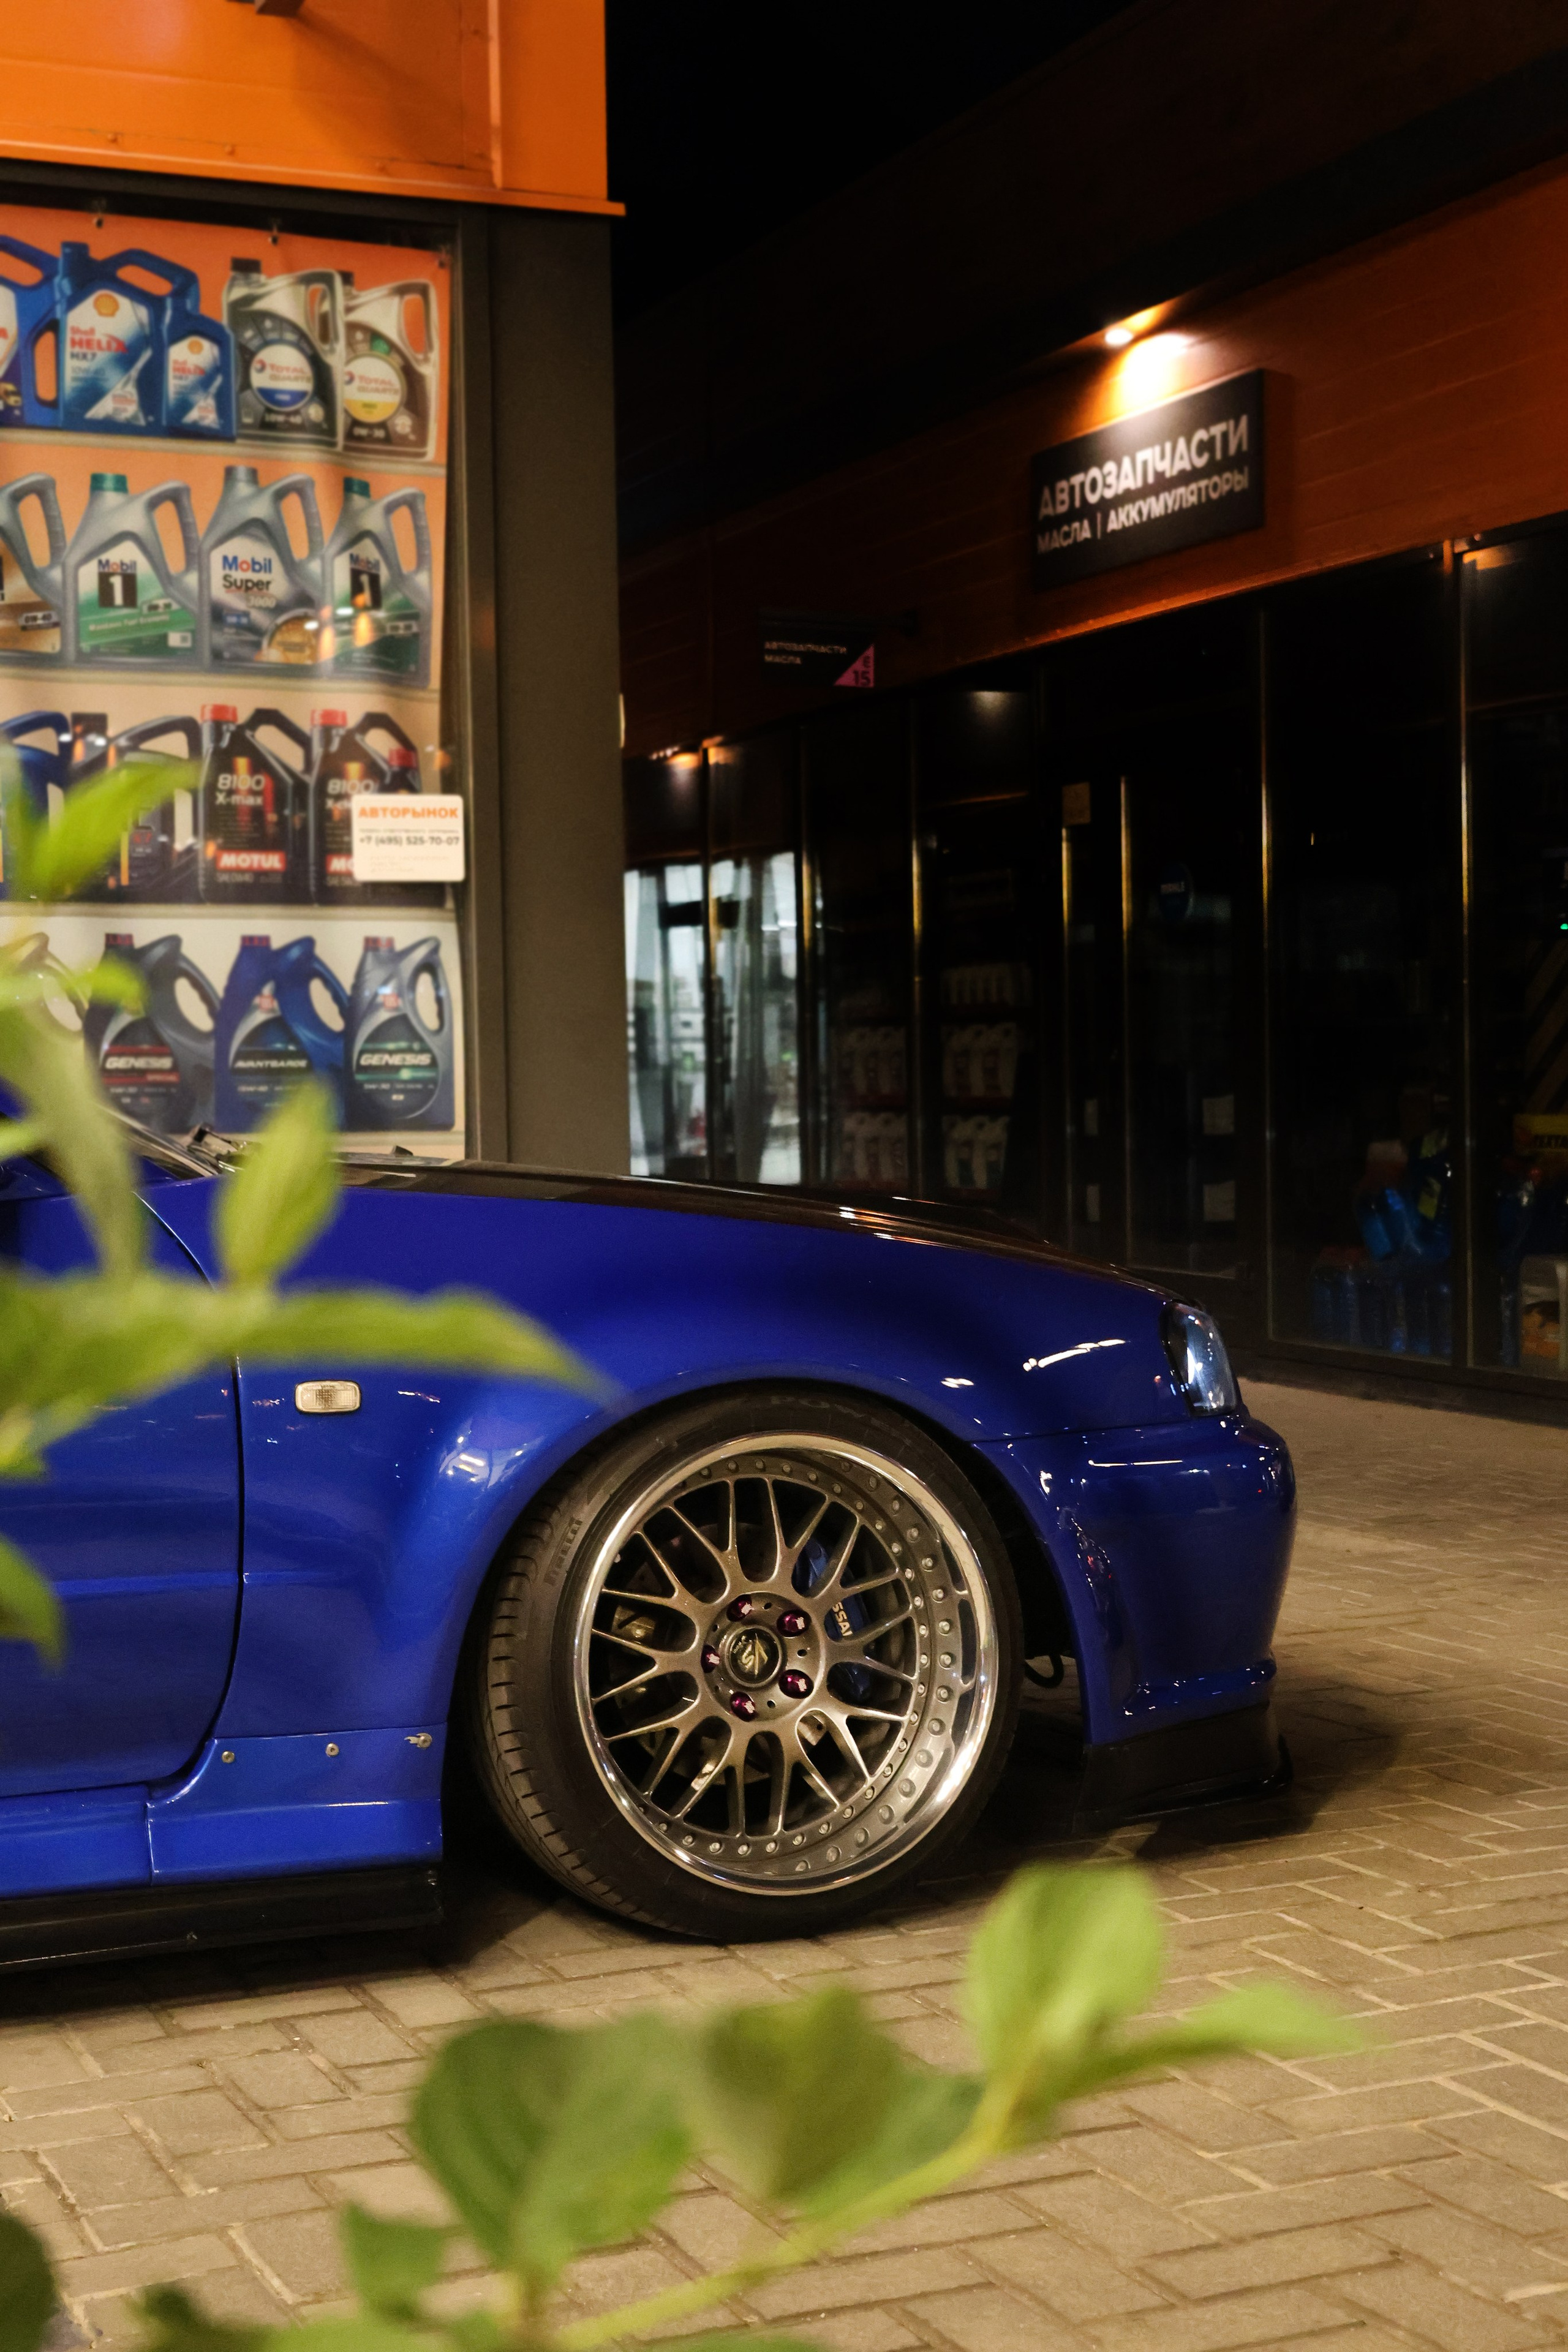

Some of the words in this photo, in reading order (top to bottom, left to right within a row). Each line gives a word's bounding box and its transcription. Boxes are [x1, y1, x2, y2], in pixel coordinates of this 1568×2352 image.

[70, 326, 96, 336] Shell
[70, 334, 128, 353] HELIX
[70, 352, 97, 361] HX7
[266, 363, 306, 375] TOTAL
[268, 372, 312, 383] QUARTZ
[357, 374, 395, 386] TOTAL
[357, 385, 399, 396] QUARTZ
[264, 412, 303, 425] 10W-40
[1039, 414, 1248, 520] АВТОЗАПЧАСТИ
[1037, 519, 1091, 554] МАСЛА
[1107, 466, 1249, 533] АККУМУЛЯТОРЫ
[98, 558, 137, 573] Mobil
[222, 554, 273, 574] Mobil
[349, 552, 380, 573] Mobil
[109, 573, 124, 607] 1
[222, 573, 273, 593] Super
[247, 595, 276, 608] 3000
[764, 654, 802, 665] МАСЛА
[853, 670, 871, 686] 15
[217, 773, 266, 790] 8100
[326, 778, 374, 796] 8100
[215, 791, 264, 806] X-max
[358, 806, 459, 819] АВТОРЫНОК
[360, 835, 372, 845] +7
[375, 835, 403, 847] (495)
[405, 835, 460, 846] 525-70-07
[219, 853, 282, 869] MOTUL
[105, 1056, 173, 1069] GENESIS
[360, 1053, 431, 1066] GENESIS
[543, 1517, 582, 1587] PIRELLI
